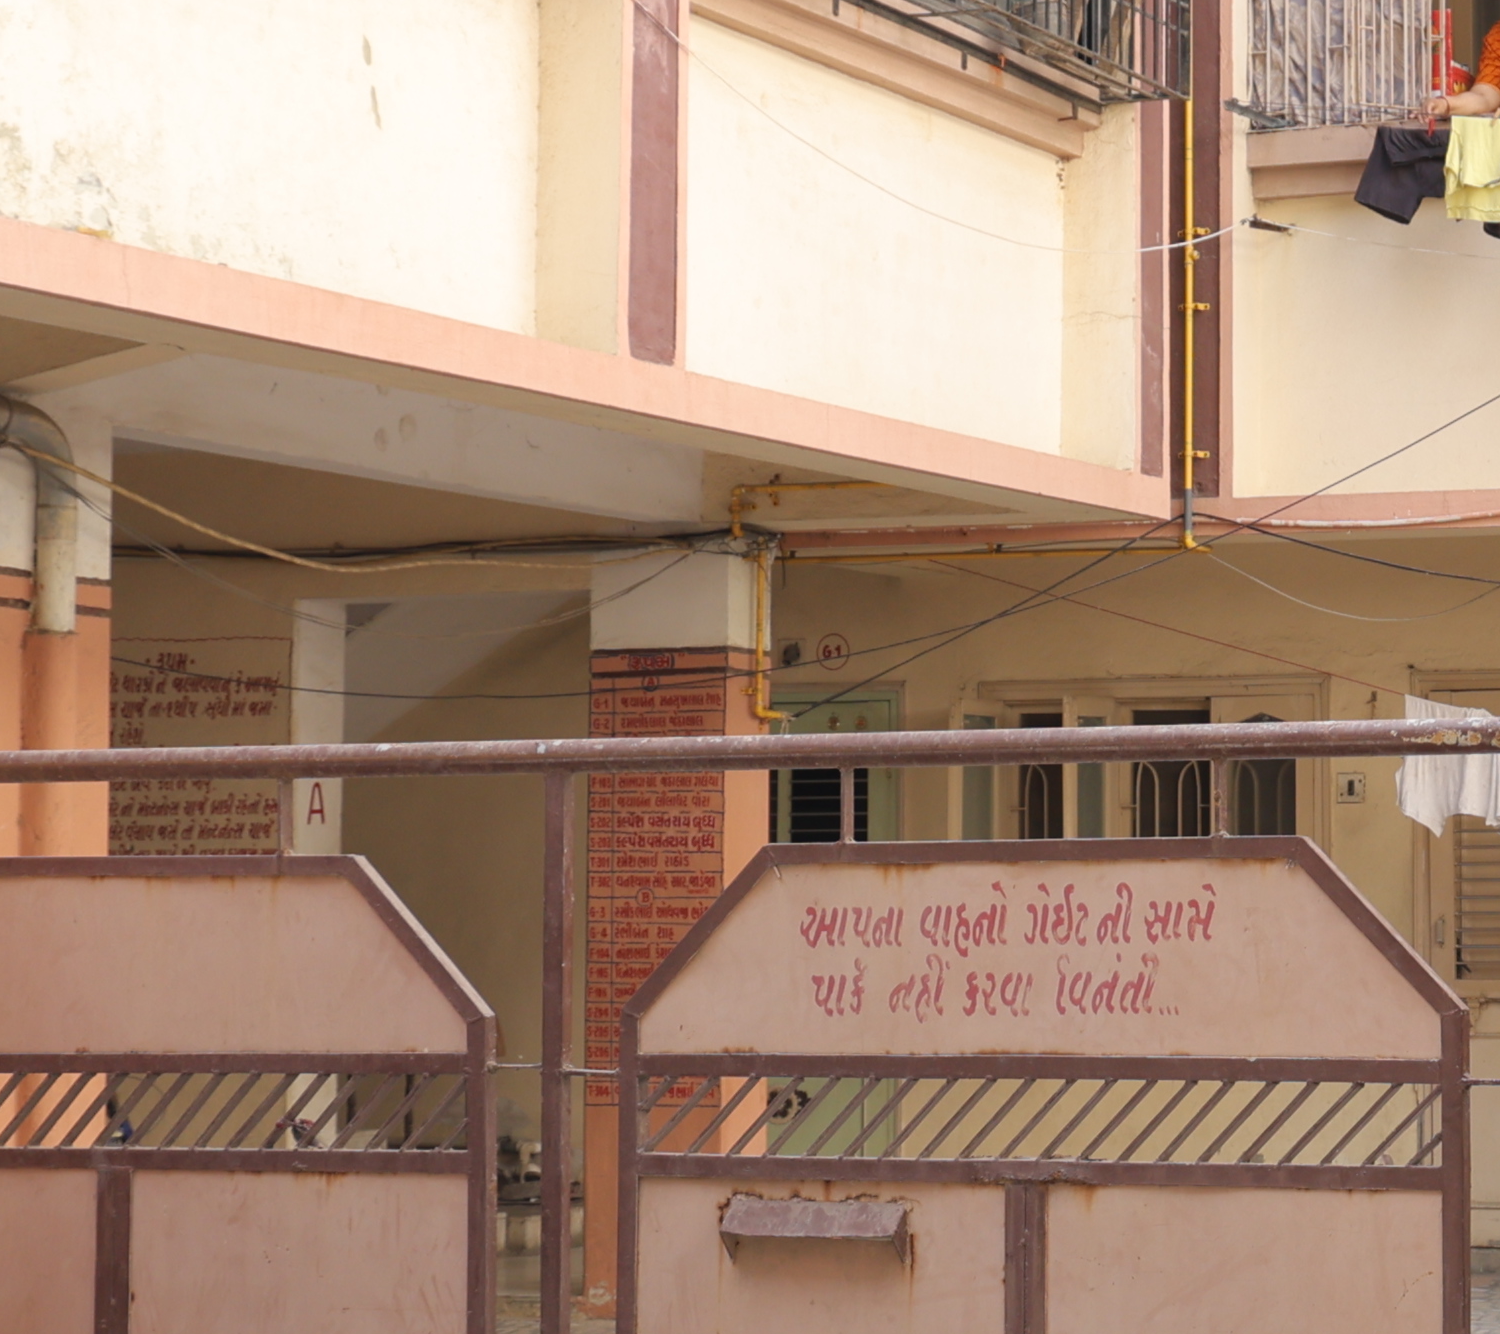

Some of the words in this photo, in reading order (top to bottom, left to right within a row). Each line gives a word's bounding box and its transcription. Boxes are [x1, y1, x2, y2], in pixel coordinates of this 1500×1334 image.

[307, 782, 326, 825] A
[800, 906, 904, 948] આપના
[920, 881, 1007, 957] વાહનો
[1097, 882, 1133, 945] ની
[1145, 883, 1217, 945] સામે
[811, 957, 868, 1017] પાર્ક
[889, 953, 950, 1024] નહીં
[962, 971, 1033, 1018] કરવા
